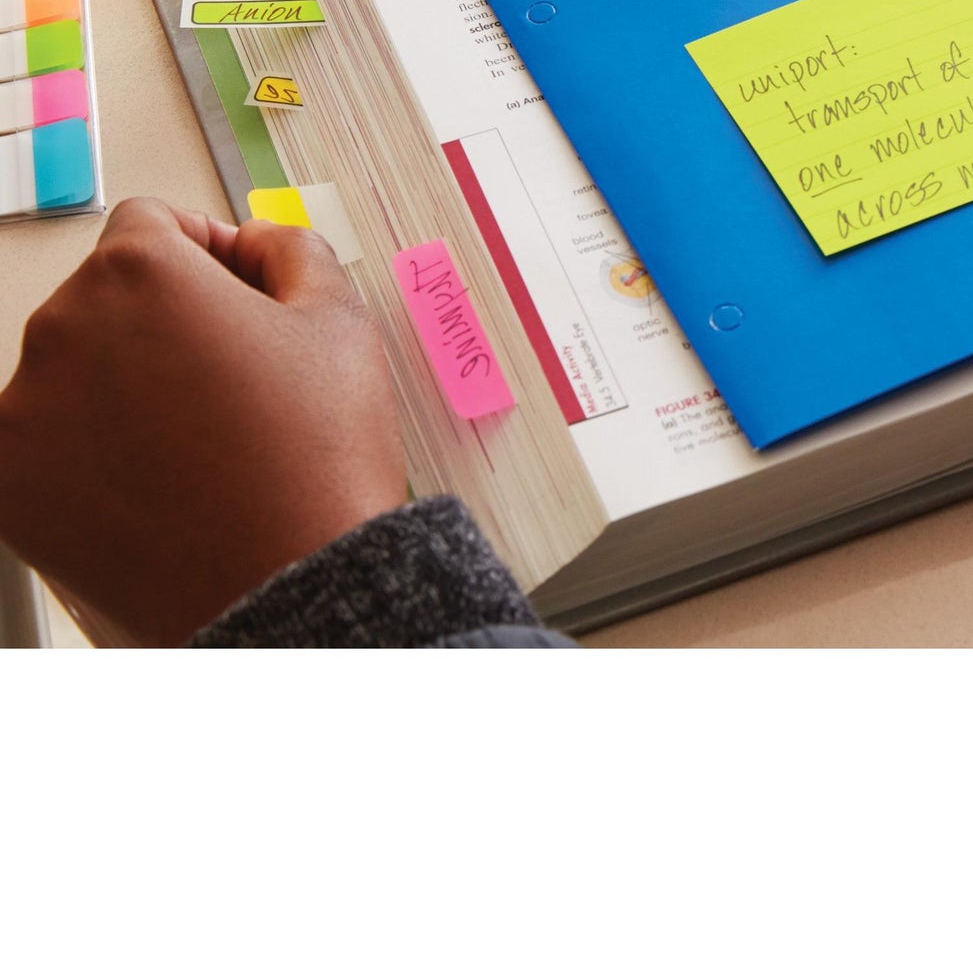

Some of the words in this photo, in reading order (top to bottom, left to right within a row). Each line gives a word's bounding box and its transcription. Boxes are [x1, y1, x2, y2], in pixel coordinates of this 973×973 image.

[218, 3, 303, 23] Anion
[485, 54, 516, 68] been
[740, 35, 858, 102] uniport:
[490, 69, 505, 79] In
[787, 58, 925, 131] transport
[940, 42, 970, 80] of
[506, 97, 521, 111] (a)
[798, 158, 854, 194] one
[577, 208, 609, 221] fovea
[835, 179, 943, 238] across
[572, 230, 605, 245] blood
[577, 238, 618, 255] vessels
[633, 317, 662, 333] optic
[637, 328, 669, 343] nerve
[655, 394, 701, 417] FIGURE
